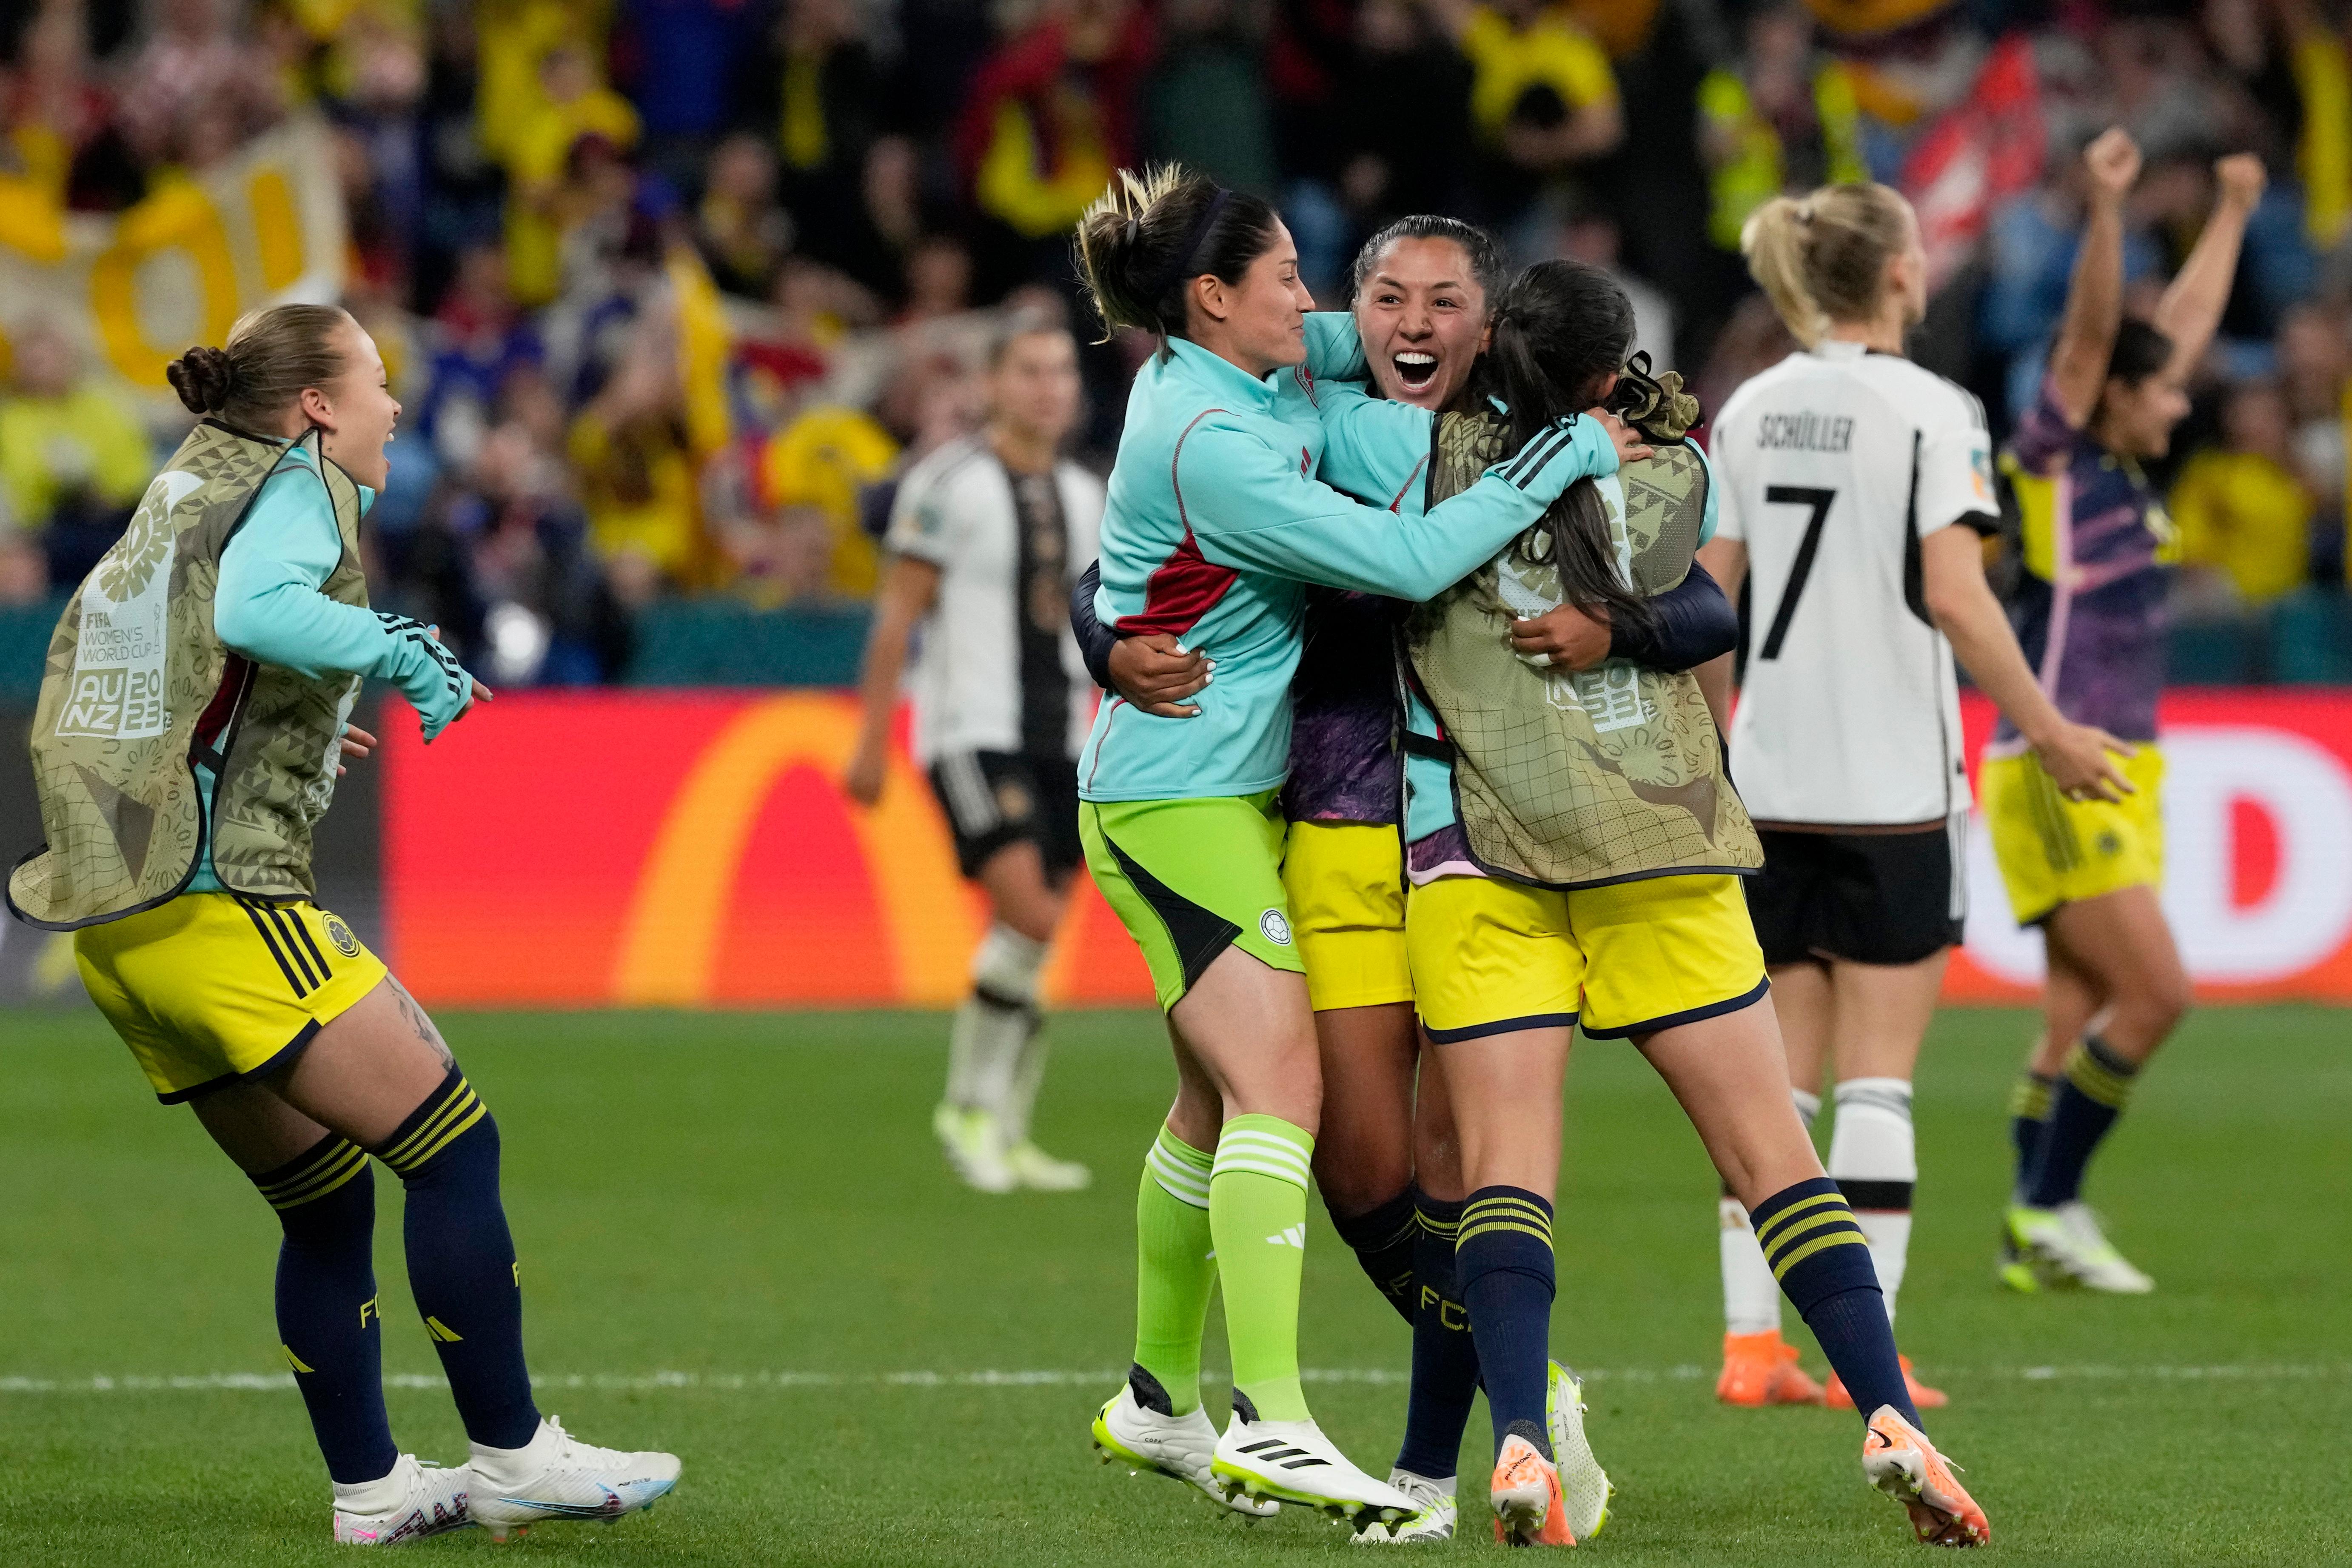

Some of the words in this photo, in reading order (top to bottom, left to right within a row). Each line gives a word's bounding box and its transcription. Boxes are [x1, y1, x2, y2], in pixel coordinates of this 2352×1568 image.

[1757, 412, 1854, 452] SCHÜLLER
[1760, 485, 1838, 660] 7
[85, 627, 143, 645] WOMEN'S
[86, 612, 112, 629] FIFA
[83, 645, 129, 662] WORLD
[132, 642, 152, 658] CUP
[75, 674, 124, 702] AU
[129, 668, 160, 700] 20
[65, 704, 120, 730] NZ
[124, 700, 160, 730] 23
[1421, 1285, 1472, 1332] FC
